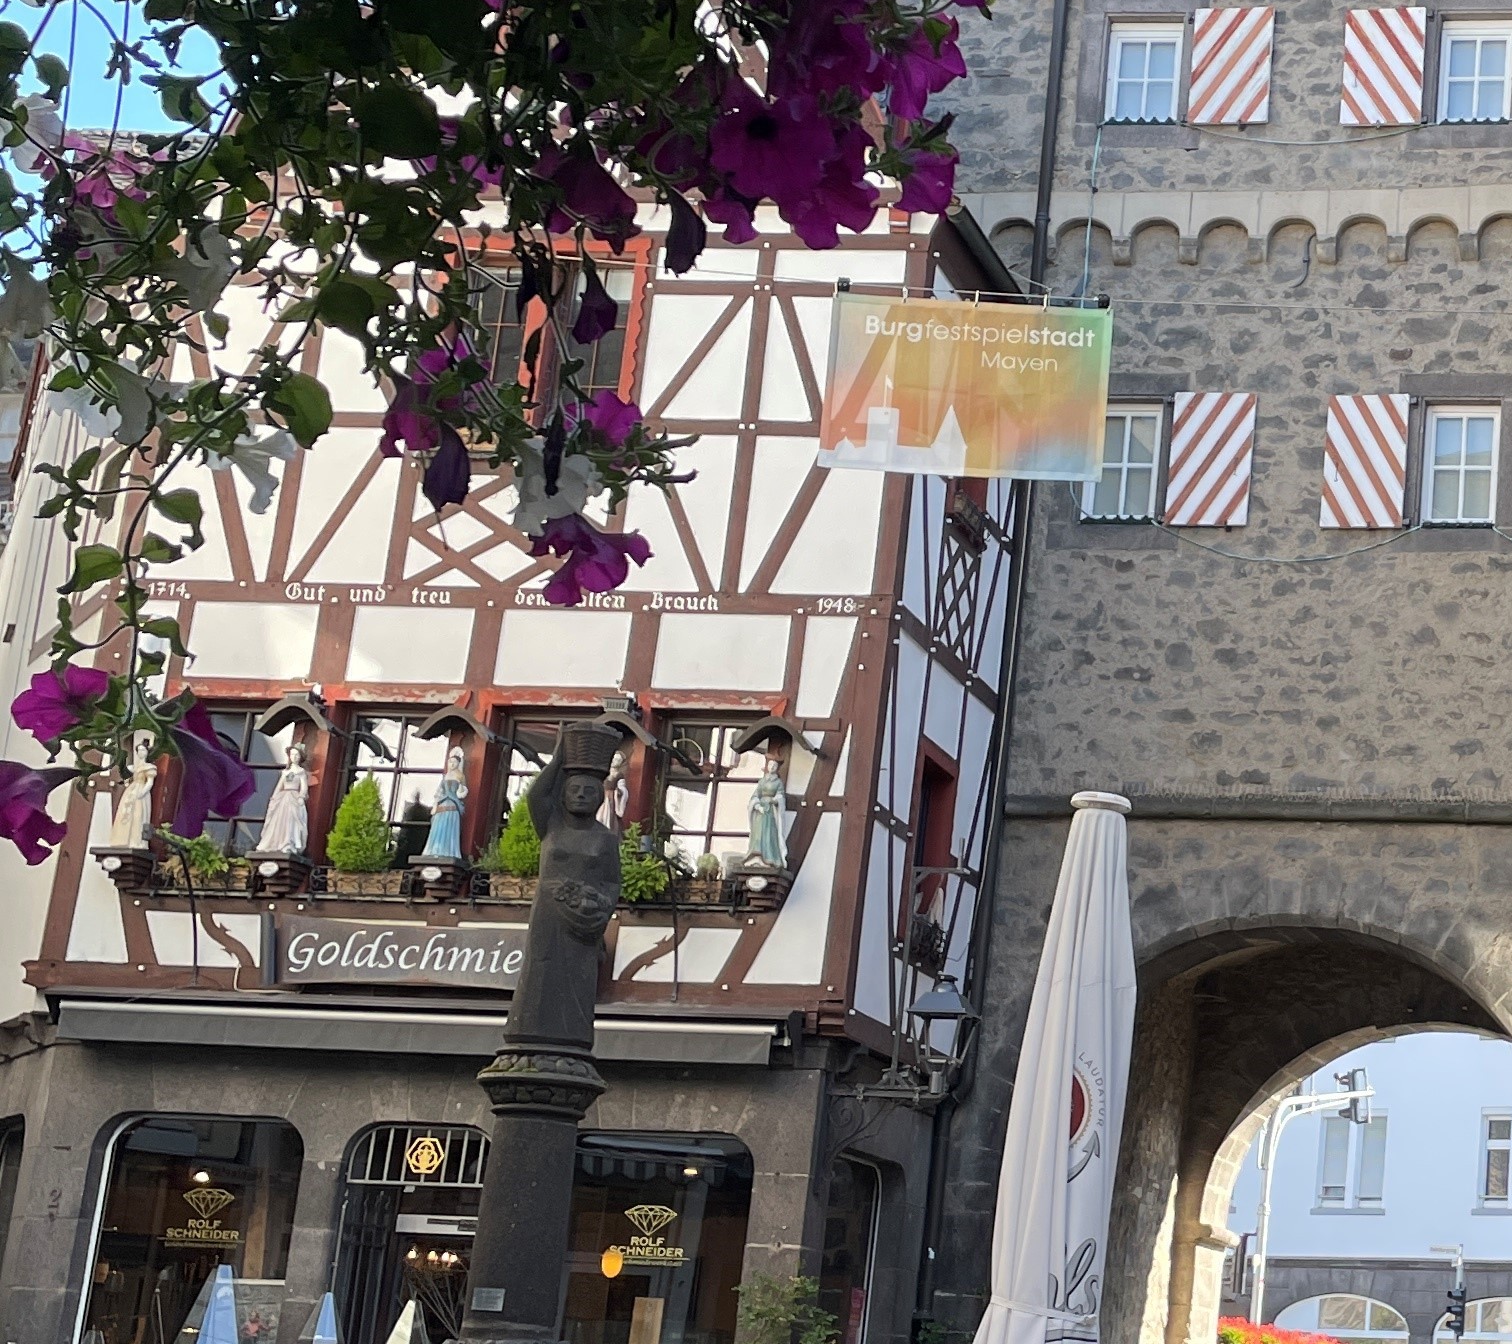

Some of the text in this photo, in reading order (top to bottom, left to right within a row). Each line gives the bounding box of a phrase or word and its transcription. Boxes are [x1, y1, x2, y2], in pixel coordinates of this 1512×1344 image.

[865, 314, 1095, 349] Burgfestspielstadt
[981, 350, 1058, 374] Mayen
[285, 583, 325, 603] Gut
[350, 584, 387, 603] und
[411, 587, 451, 605] treu
[650, 591, 720, 611] Brauch
[188, 1219, 222, 1229] ROLF
[166, 1227, 240, 1241] SCHNEIDER
[630, 1236, 665, 1246] ROLF
